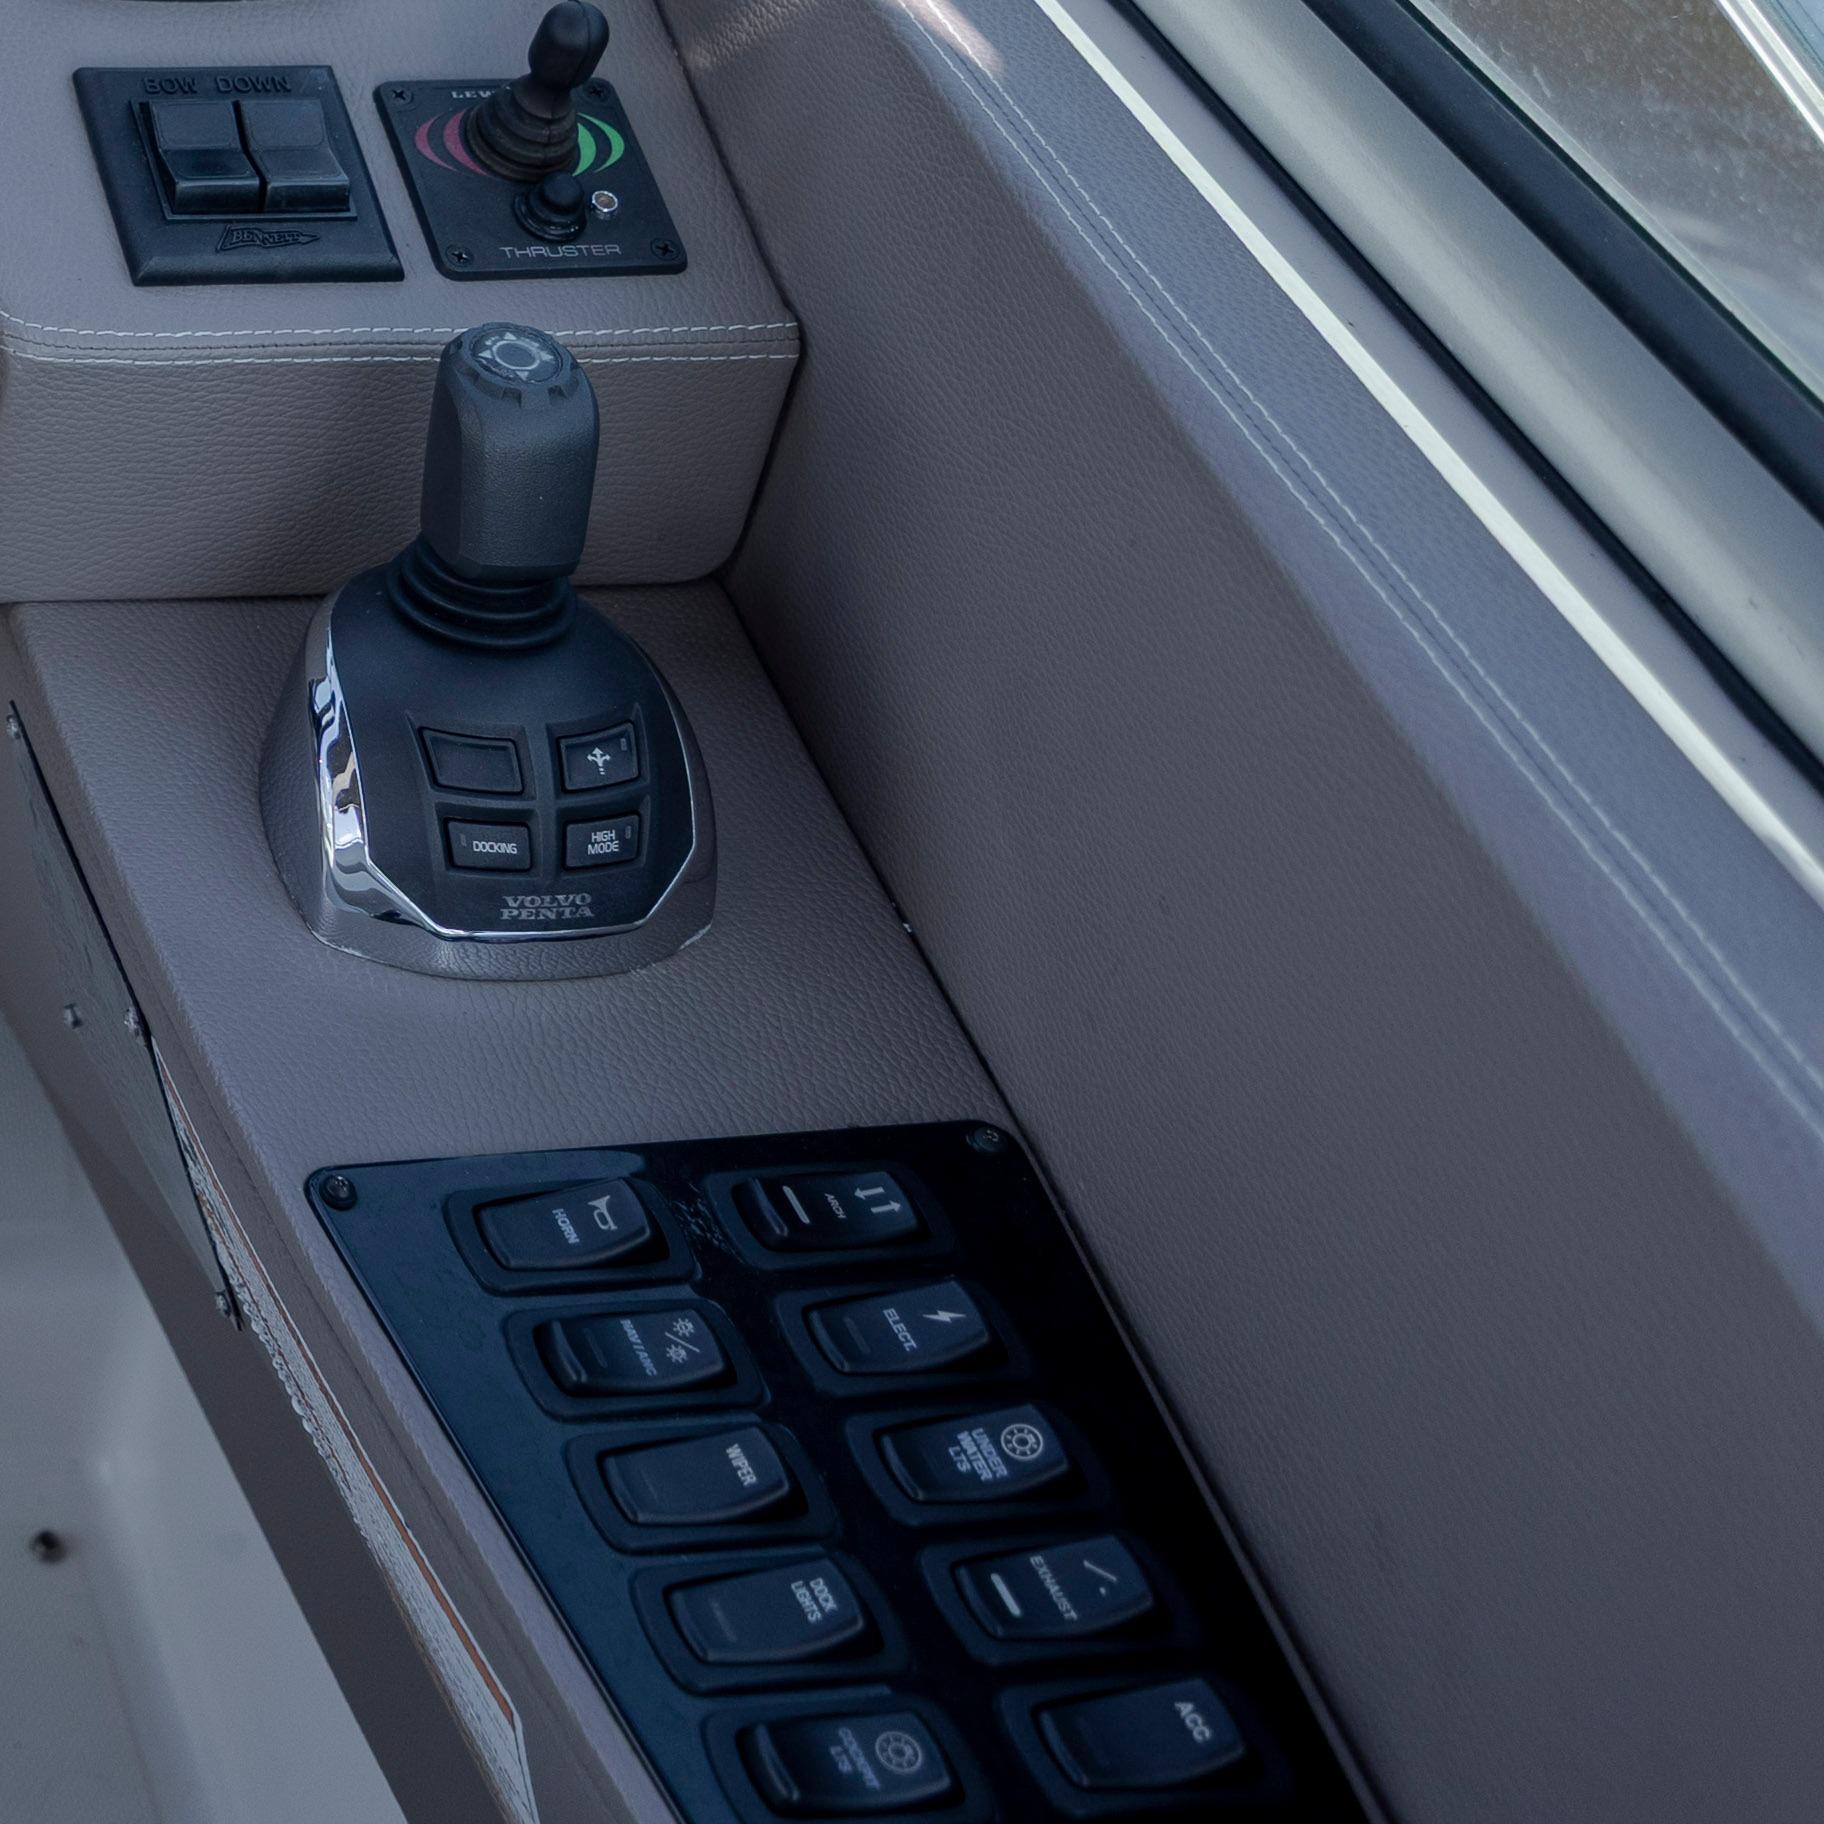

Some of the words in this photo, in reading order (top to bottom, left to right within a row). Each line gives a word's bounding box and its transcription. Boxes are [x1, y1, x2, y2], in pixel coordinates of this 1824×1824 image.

[143, 75, 198, 95] BOW
[215, 74, 293, 95] DOWN
[229, 226, 309, 247] BENNETT
[499, 244, 622, 260] THRUSTER
[472, 840, 519, 855] DOCKING
[586, 840, 620, 856] MODE
[590, 829, 617, 844] HIGH
[499, 906, 596, 921] PENTA
[502, 892, 593, 909] VOLVO
[823, 1192, 847, 1220] ARCH
[551, 1208, 581, 1246] HORN
[725, 1442, 758, 1487] WIPER
[947, 1445, 972, 1474] LTS
[956, 1430, 994, 1483] WATER
[970, 1427, 1009, 1479] UNDER
[809, 1577, 839, 1614] DOCK
[1029, 1554, 1079, 1621] EXHAUST
[790, 1580, 823, 1624] LIGHTS
[1174, 1701, 1212, 1743] ACC
